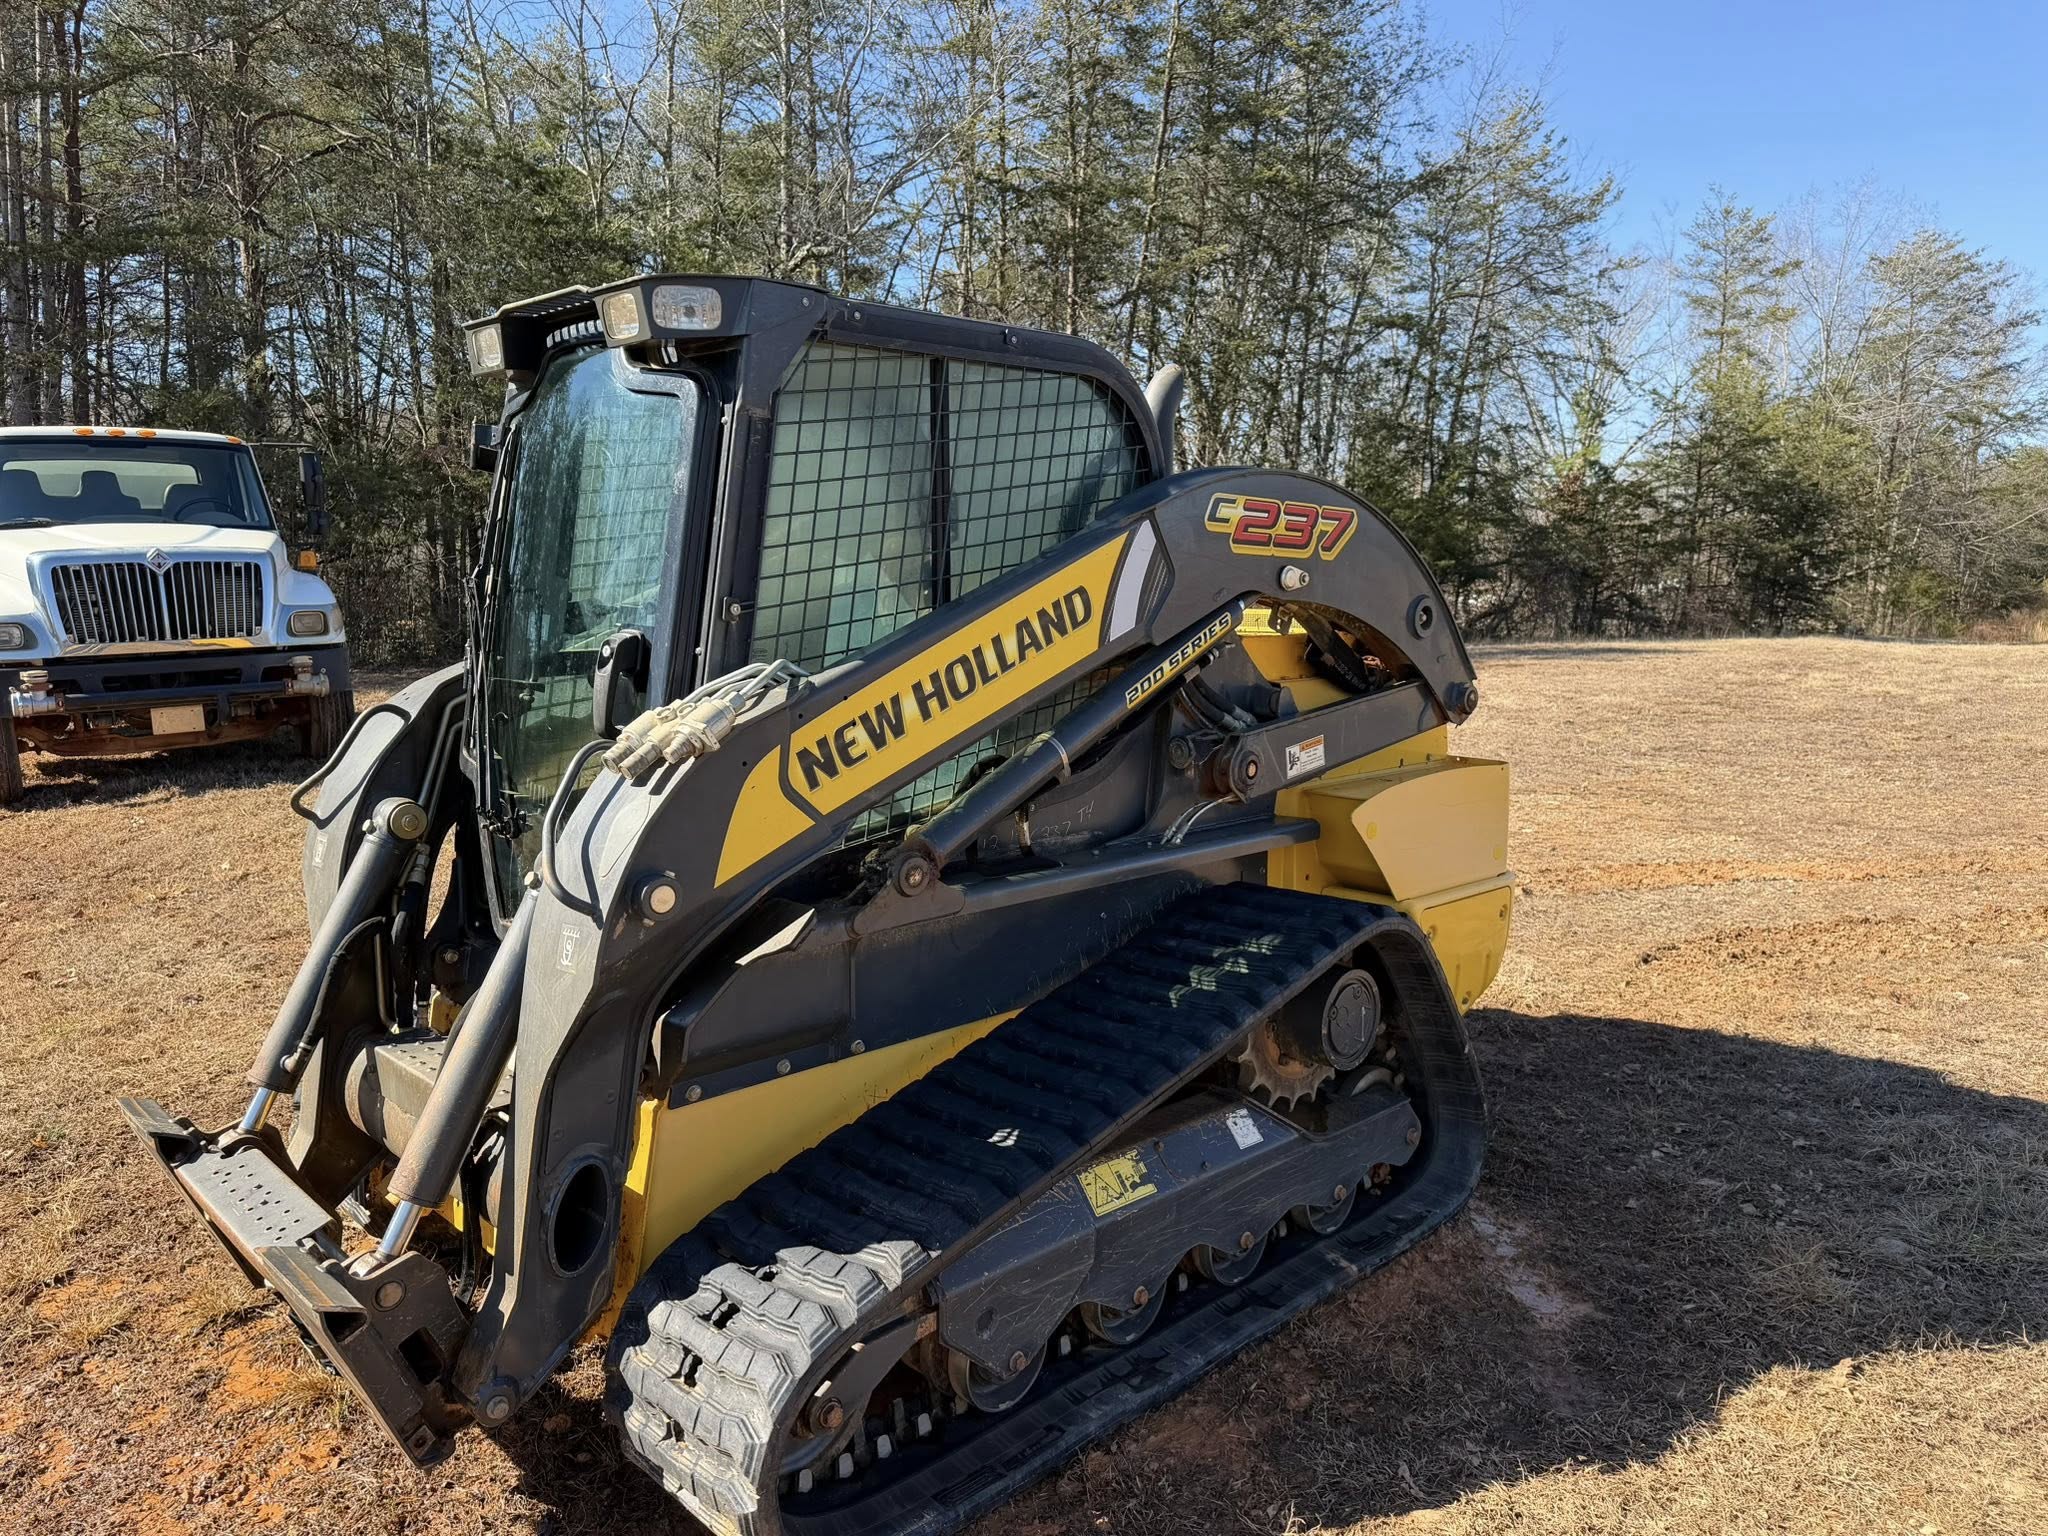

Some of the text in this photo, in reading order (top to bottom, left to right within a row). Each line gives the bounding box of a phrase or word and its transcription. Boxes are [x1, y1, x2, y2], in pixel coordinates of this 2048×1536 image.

[1205, 493, 1358, 560] C237
[795, 584, 1093, 793] NEW HOLLAND
[1126, 613, 1231, 706] 200 SERIES
